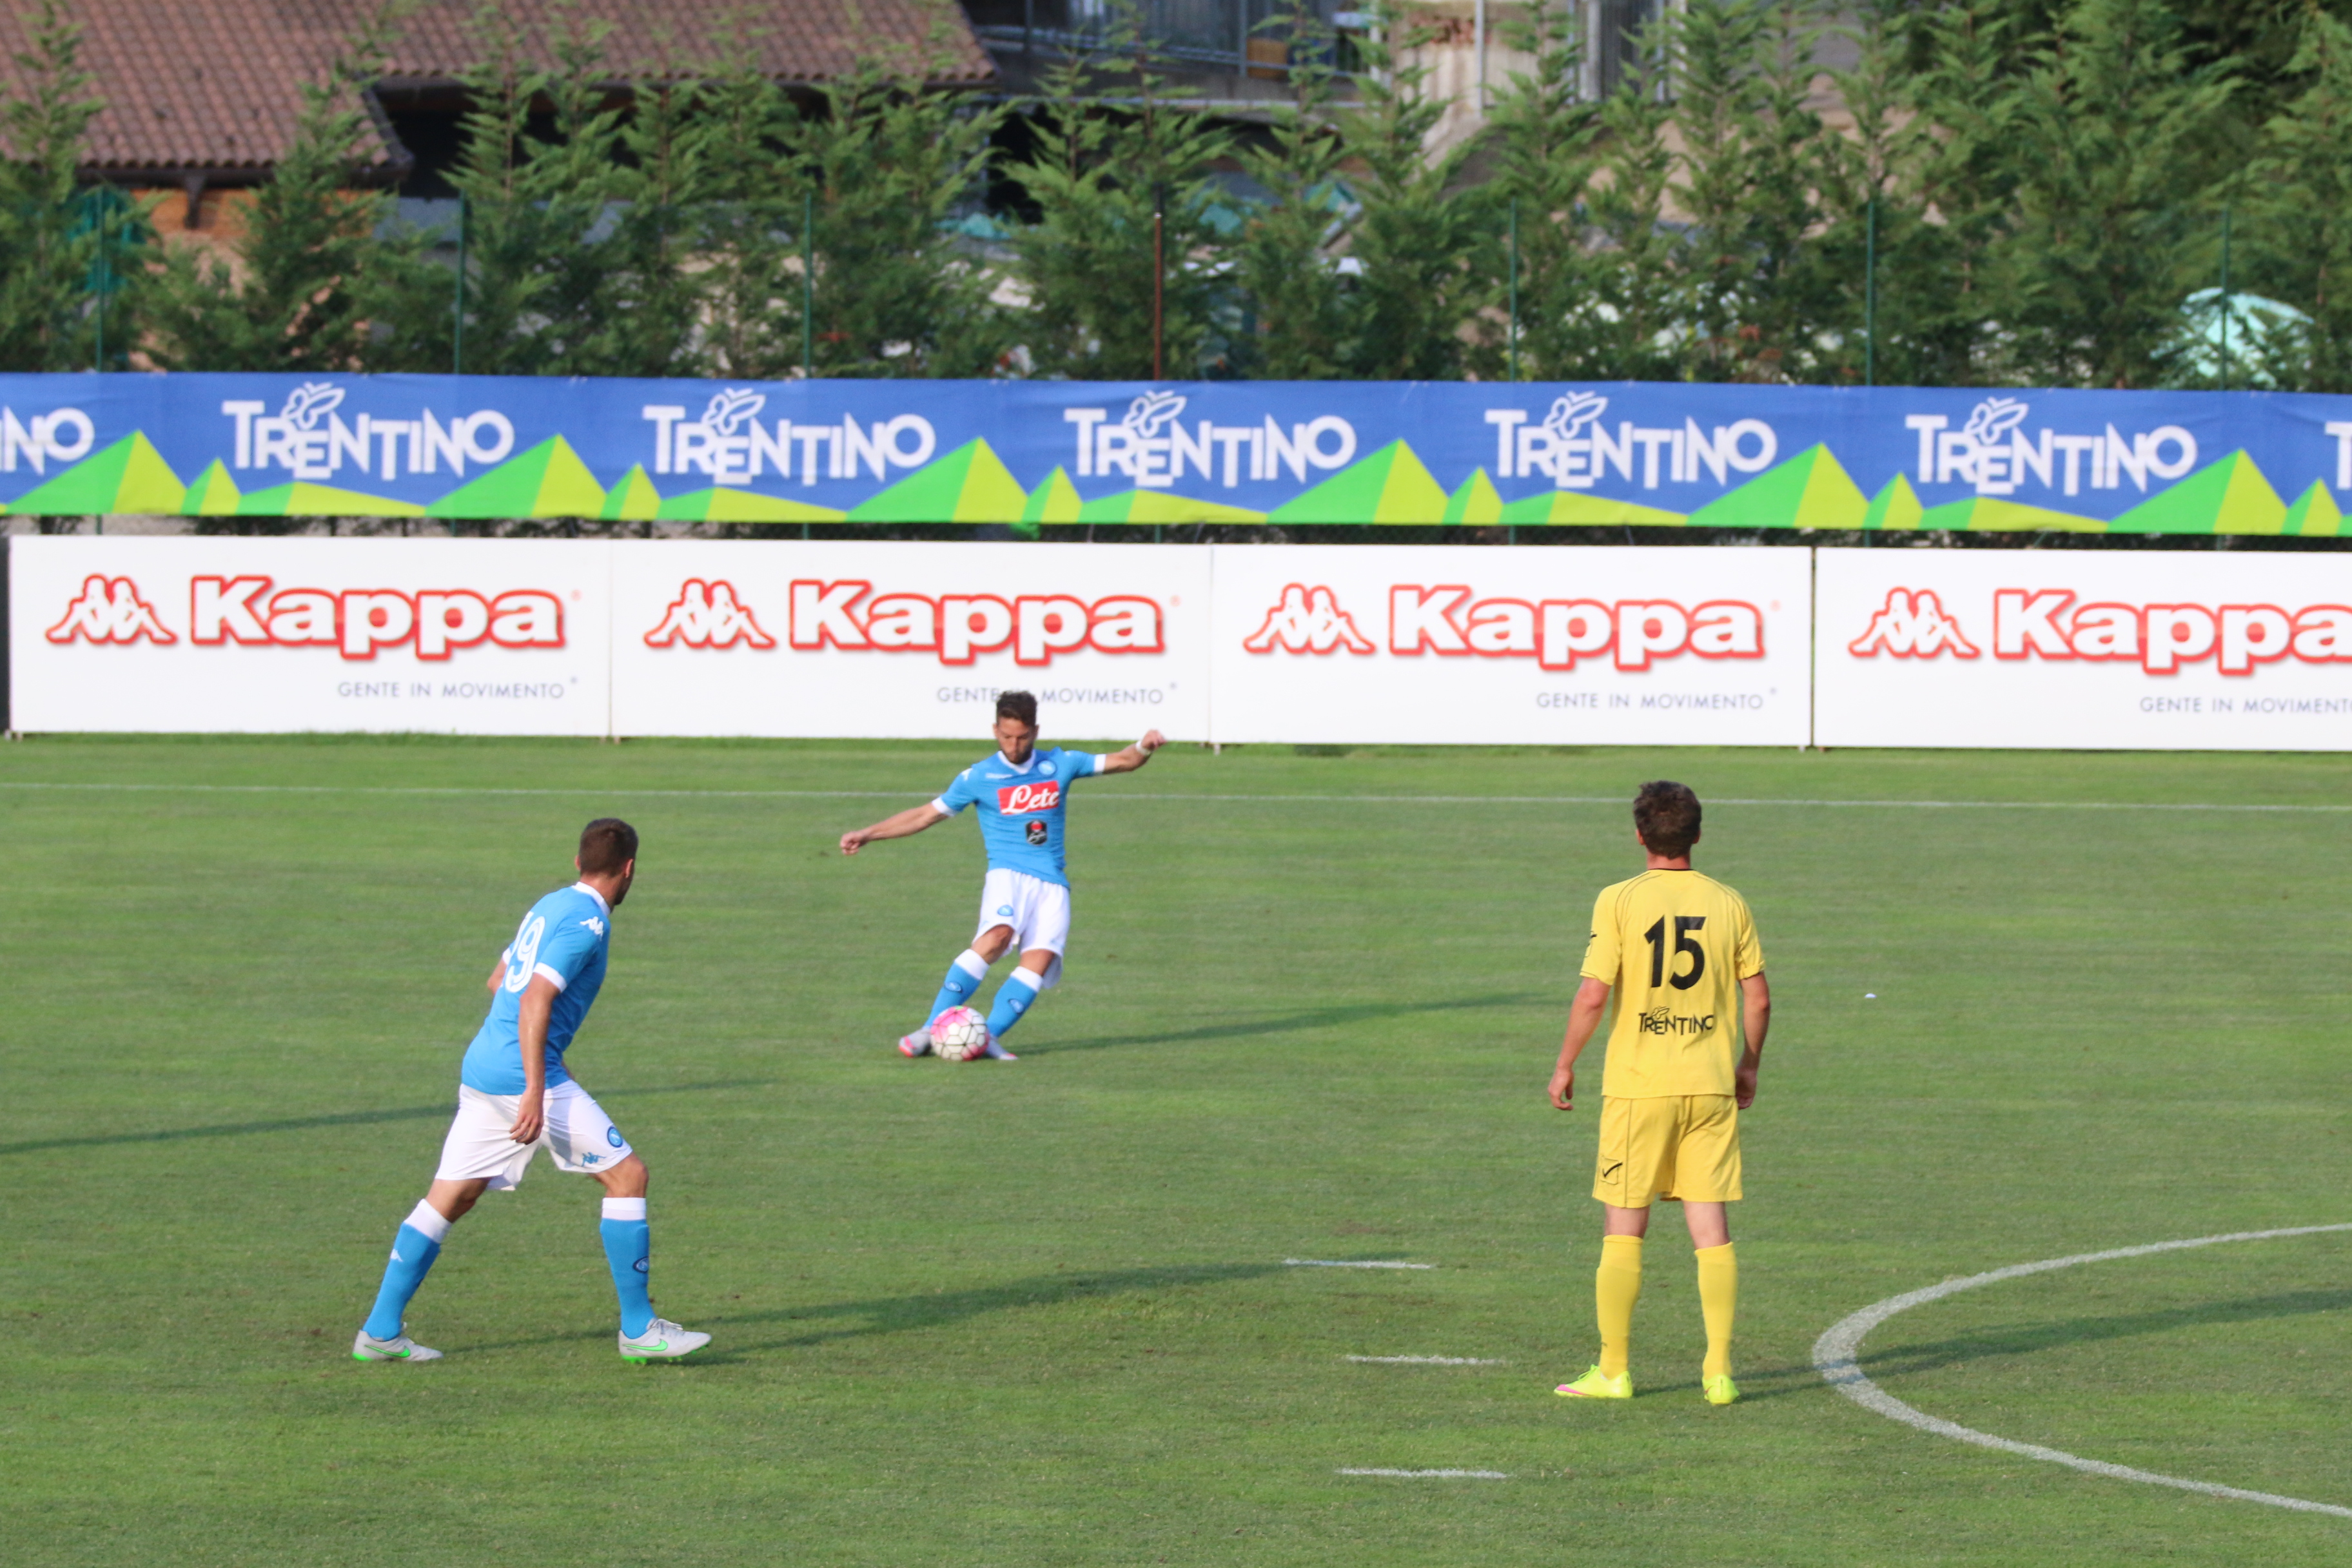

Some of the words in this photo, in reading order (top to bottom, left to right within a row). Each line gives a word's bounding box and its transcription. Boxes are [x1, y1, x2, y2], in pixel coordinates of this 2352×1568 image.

[0, 405, 95, 476] NO
[222, 400, 514, 480] TRENTINO
[642, 406, 936, 486] TRENTINO
[1064, 408, 1357, 487] TRENTINO
[1484, 409, 1778, 489] TRENTINO
[1905, 415, 2197, 496] TRENTINO
[190, 574, 567, 662] Kappa
[789, 578, 1166, 668] Kappa
[1388, 583, 1767, 673] Kappa
[1992, 587, 2352, 678] Kappa
[337, 681, 400, 699] GENTE
[409, 682, 431, 698] IN
[442, 682, 565, 701] MOVIMENTO
[1041, 687, 1164, 705] MOVIMENTO
[1535, 692, 1598, 710] GENTE
[1608, 693, 1630, 709] IN
[1640, 693, 1765, 711] MOVIMENTO
[2139, 696, 2202, 714] GENTE
[2211, 697, 2234, 713] IN
[2243, 697, 2352, 714] MOVIMENT
[1001, 784, 1060, 814] Lete
[1644, 914, 1707, 990] 15
